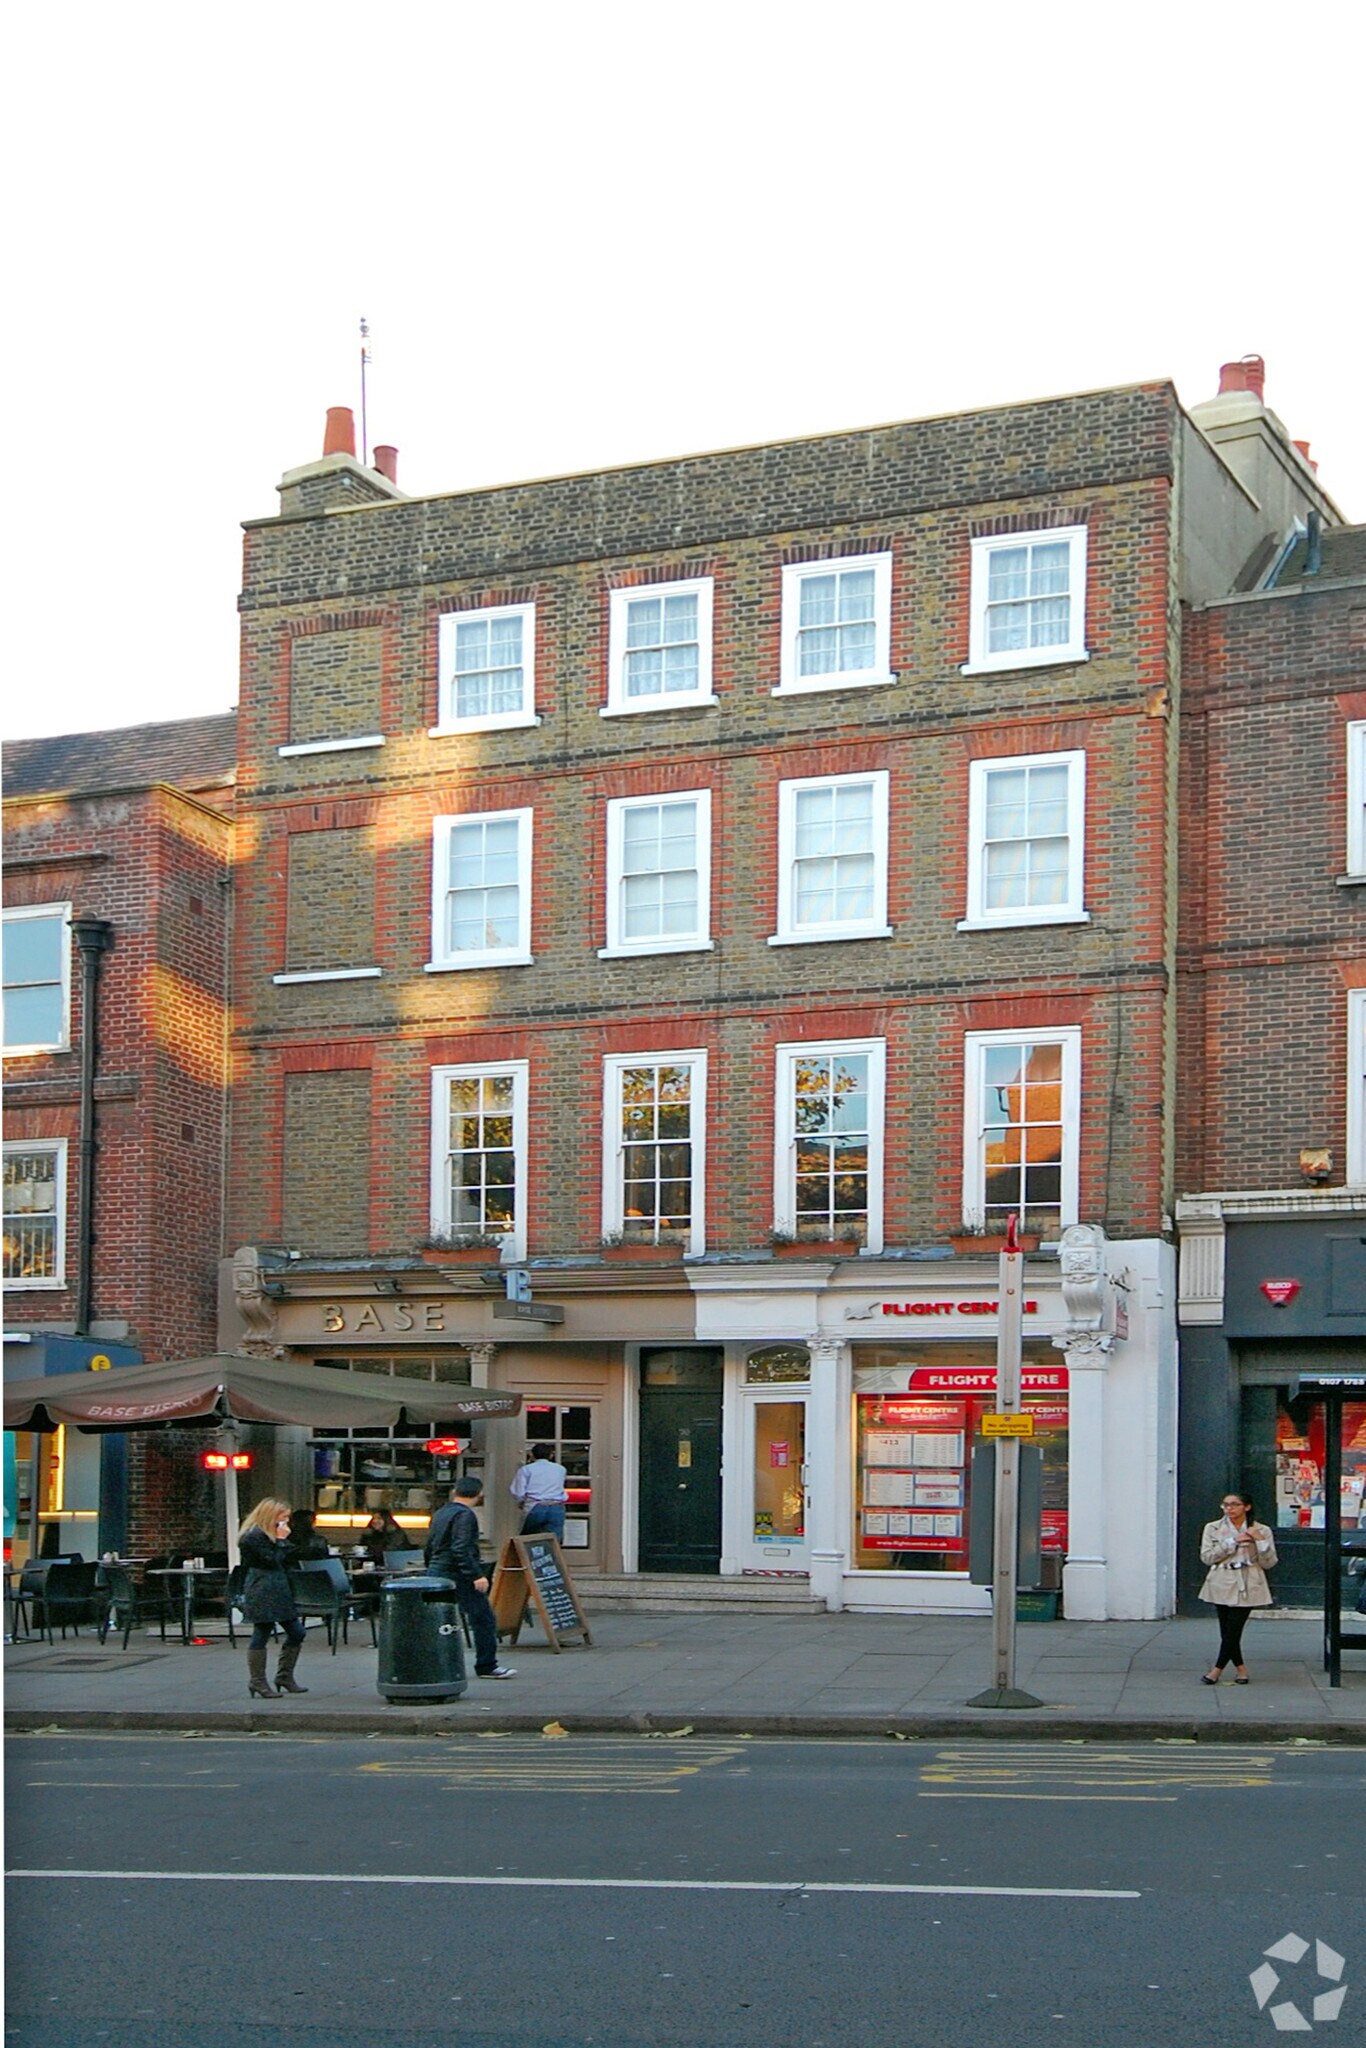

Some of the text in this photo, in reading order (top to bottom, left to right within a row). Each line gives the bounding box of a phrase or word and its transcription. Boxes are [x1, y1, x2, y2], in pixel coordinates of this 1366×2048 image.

[507, 1270, 533, 1303] B
[882, 1301, 1038, 1316] FLIGHT CENE
[322, 1302, 445, 1332] BASE
[929, 1374, 1059, 1385] FLIGHT TRE
[88, 1406, 138, 1417] BASE
[458, 1401, 485, 1412] BASE
